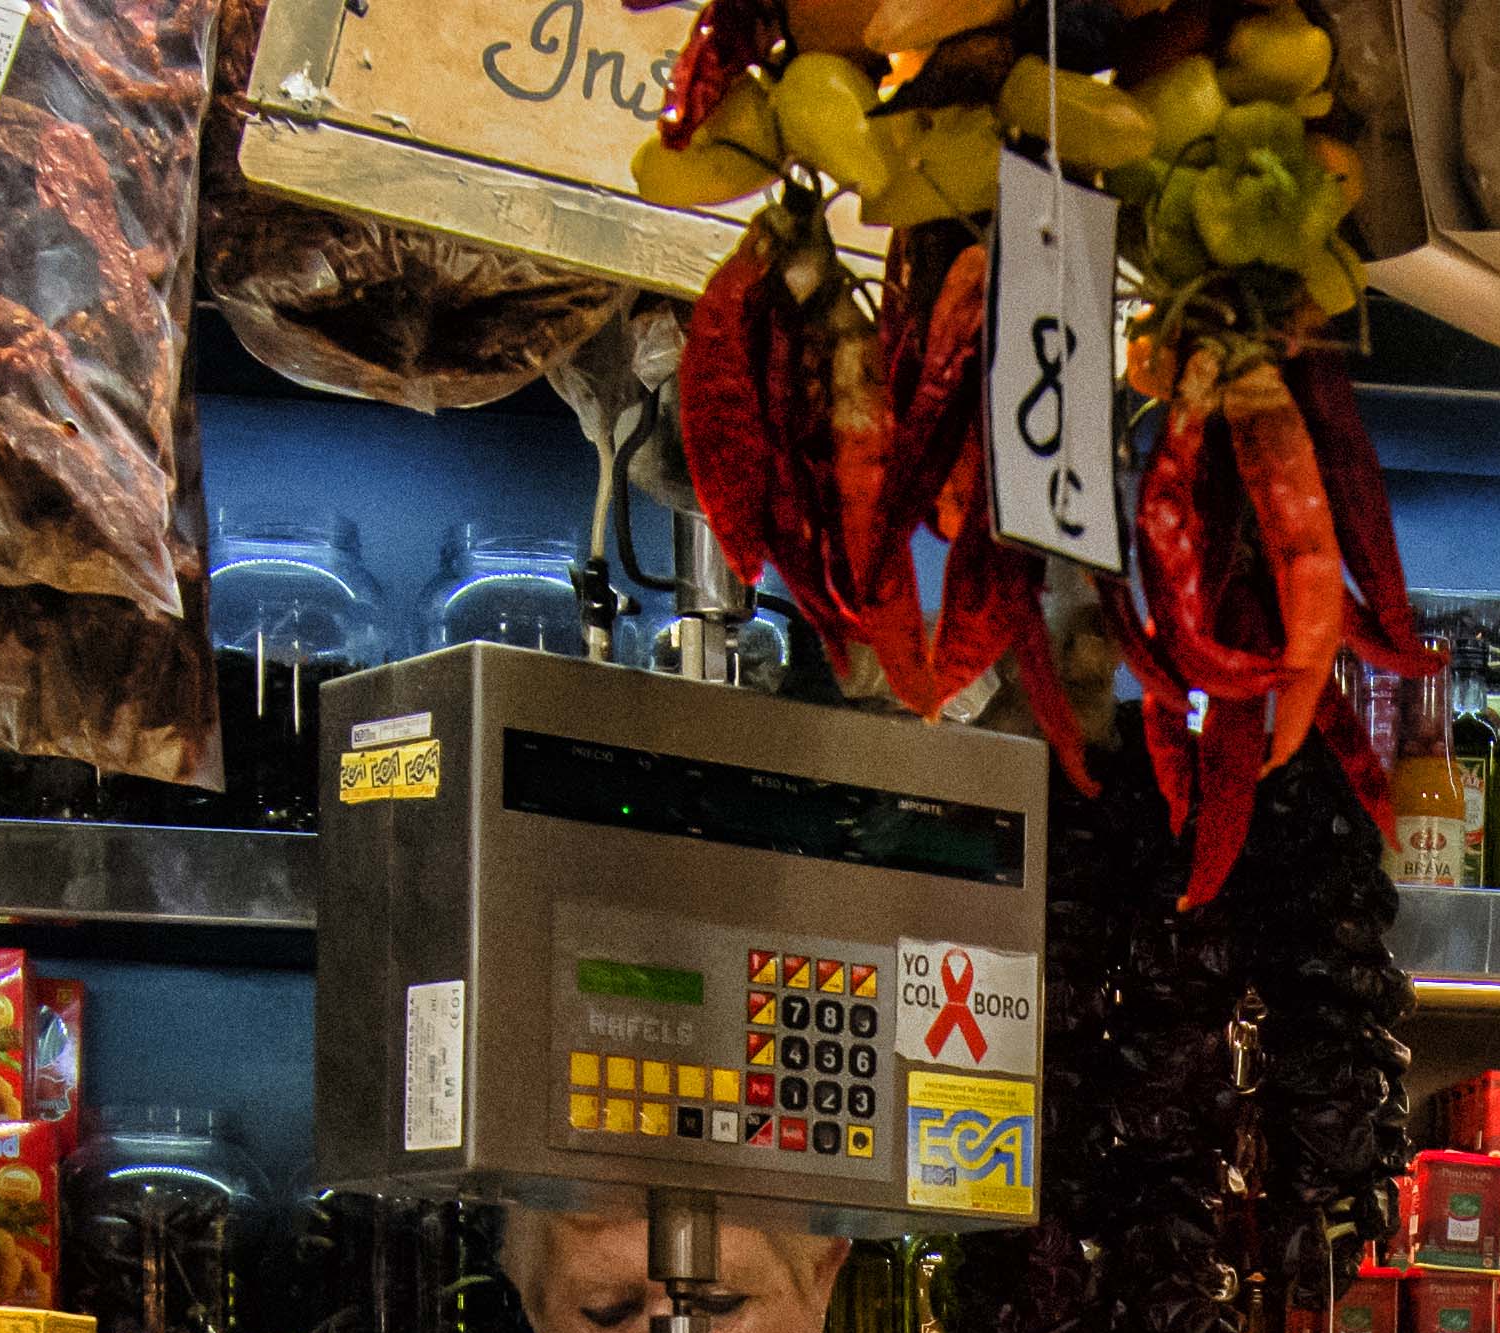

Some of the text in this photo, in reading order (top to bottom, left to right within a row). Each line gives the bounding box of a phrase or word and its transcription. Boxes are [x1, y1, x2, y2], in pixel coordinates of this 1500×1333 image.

[1404, 860, 1453, 878] BRAVA
[903, 952, 930, 977] YO
[973, 993, 1031, 1021] BORO
